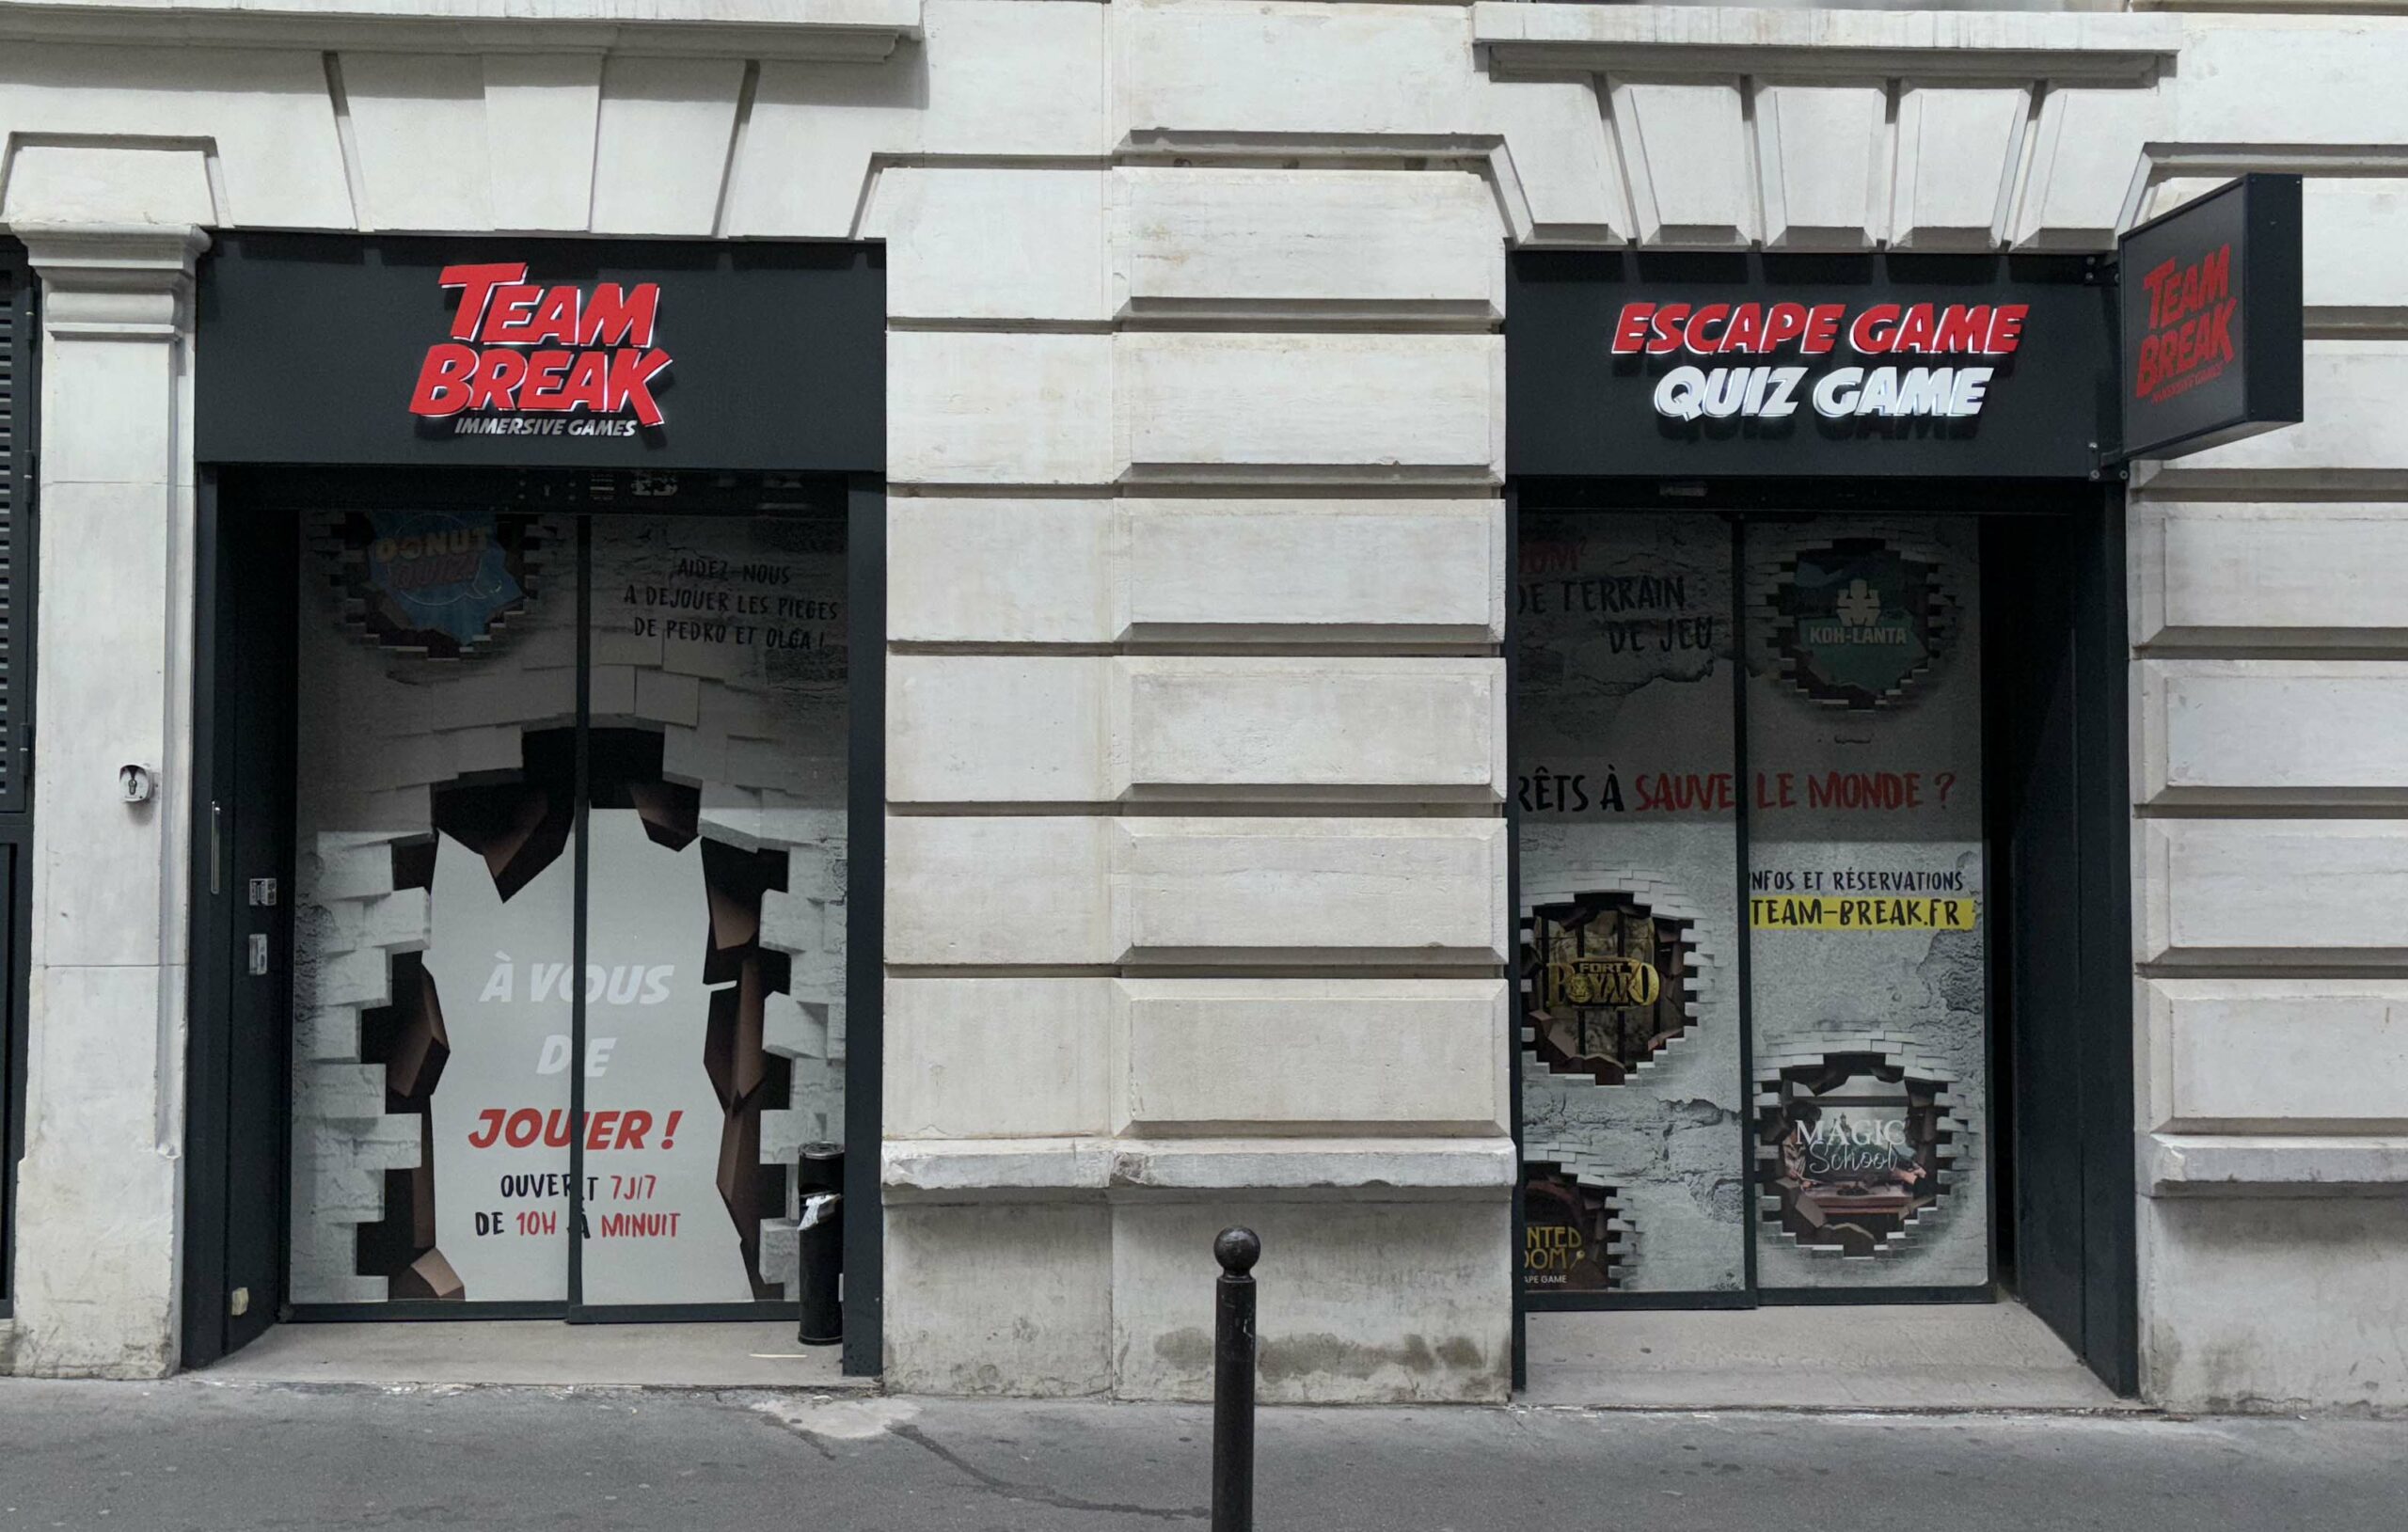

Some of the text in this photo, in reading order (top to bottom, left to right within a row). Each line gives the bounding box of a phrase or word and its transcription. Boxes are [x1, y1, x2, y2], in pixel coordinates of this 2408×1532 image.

[2144, 243, 2230, 330] TEAM
[438, 262, 660, 348] TEAM
[1611, 303, 2029, 355] ESCAPE GAME
[2136, 296, 2237, 400] BREAK
[408, 343, 673, 428] BREAK
[1655, 366, 1994, 421] QUIZ GAME
[455, 417, 638, 437] IMMERSIVE GAMES
[737, 595, 768, 614] LES
[1560, 575, 1686, 613] TERRAIN
[635, 617, 657, 637] DE
[667, 620, 726, 643] PEDRO
[736, 626, 754, 645] ET
[767, 628, 811, 650] OLGA
[1660, 616, 1712, 652] JEU
[1810, 626, 1908, 645] KOH-LANTA
[1518, 766, 1589, 813] RÊTS
[1600, 765, 1624, 813] À
[1635, 772, 1736, 813] SAUVE
[1757, 772, 1797, 809] LE
[1809, 771, 1925, 810] MONDE
[1749, 867, 1964, 892] NFOS ET RÉSERVATIONS
[1751, 898, 1961, 926] TEAM-BREAK.FR
[479, 950, 675, 1004] À VOUS
[1579, 963, 1624, 973] FORT
[536, 1034, 617, 1078] DE
[468, 1108, 653, 1150] JOUER
[1795, 1119, 1906, 1145] MAGIC
[475, 1211, 505, 1237] DE
[516, 1210, 557, 1236] 10H
[601, 1212, 681, 1239] MINUIT
[1526, 1225, 1583, 1249] NTED
[1541, 1274, 1568, 1284] GAME
